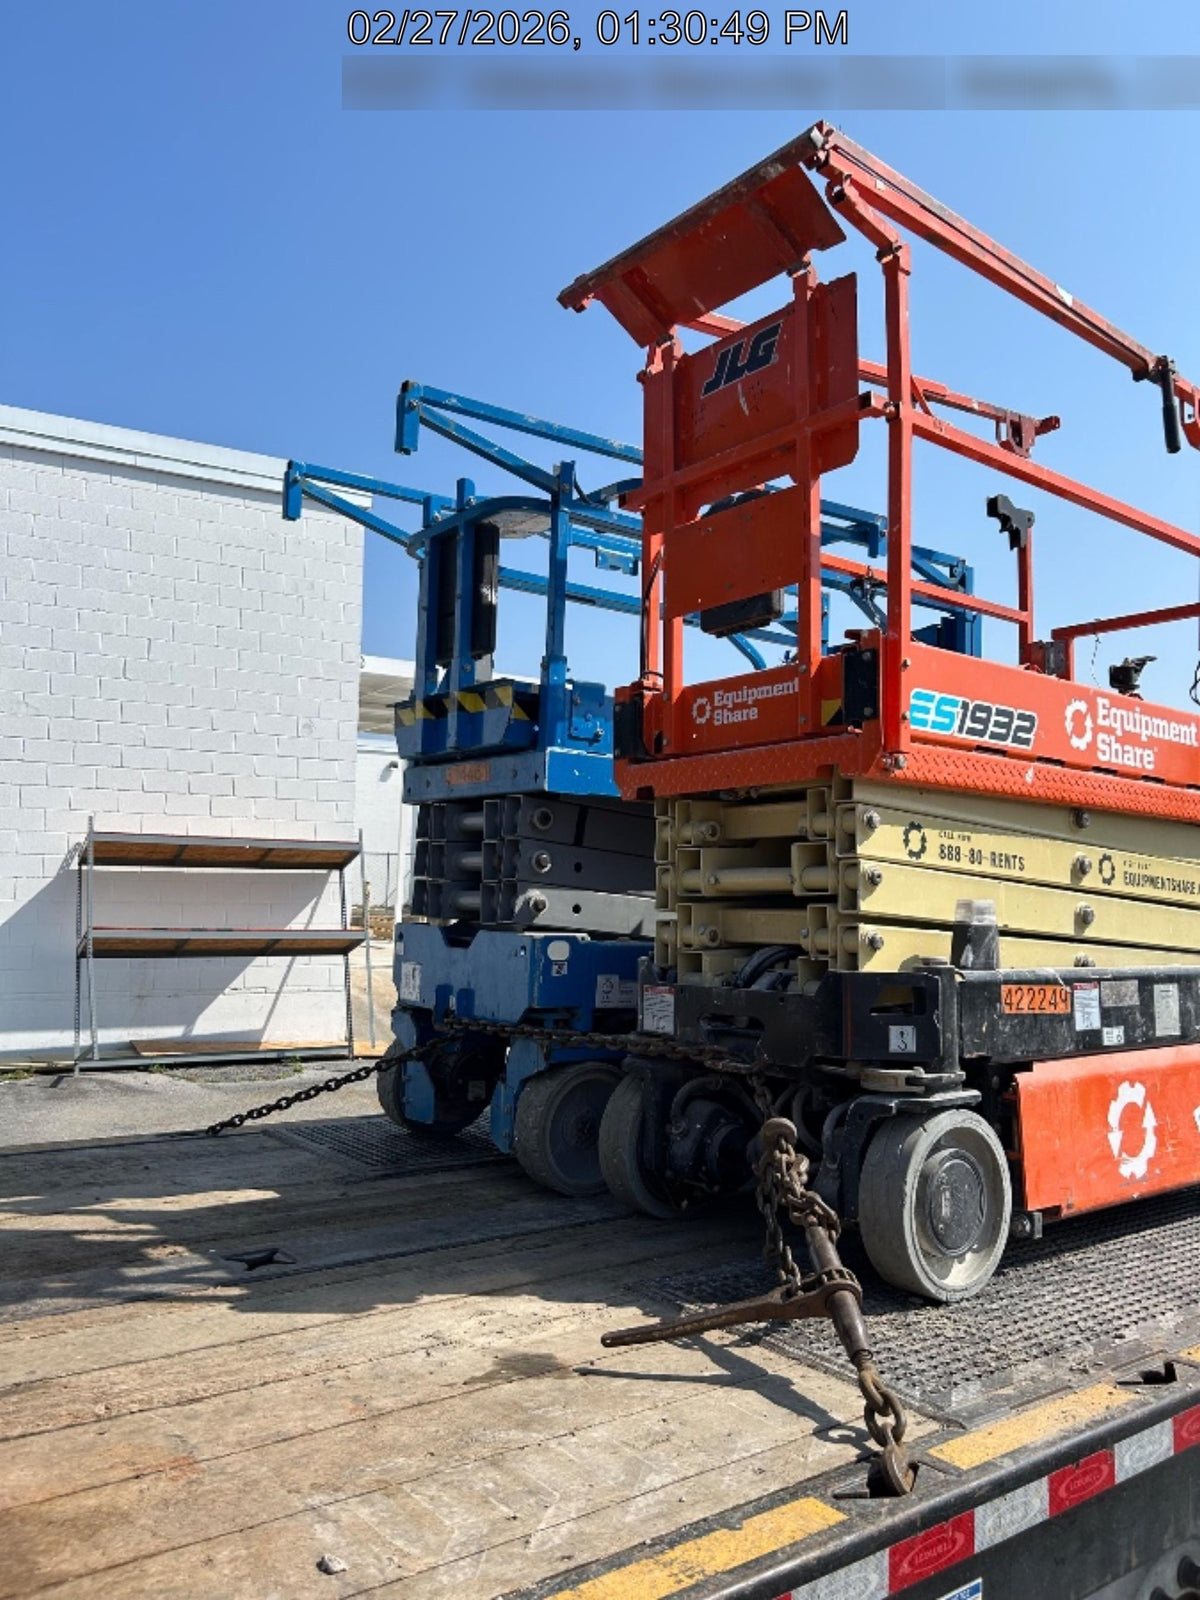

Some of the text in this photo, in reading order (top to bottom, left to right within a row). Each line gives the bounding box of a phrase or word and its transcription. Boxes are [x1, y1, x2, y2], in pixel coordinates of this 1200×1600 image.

[702, 320, 783, 398] JLG
[714, 677, 799, 708] Equipment
[714, 707, 758, 726] Share
[910, 688, 1037, 750] ES1932
[1096, 697, 1199, 747] Equipment
[1096, 733, 1155, 770] Share
[939, 843, 1025, 871] 888-80-RENTS
[1004, 986, 1069, 1012] 422249
